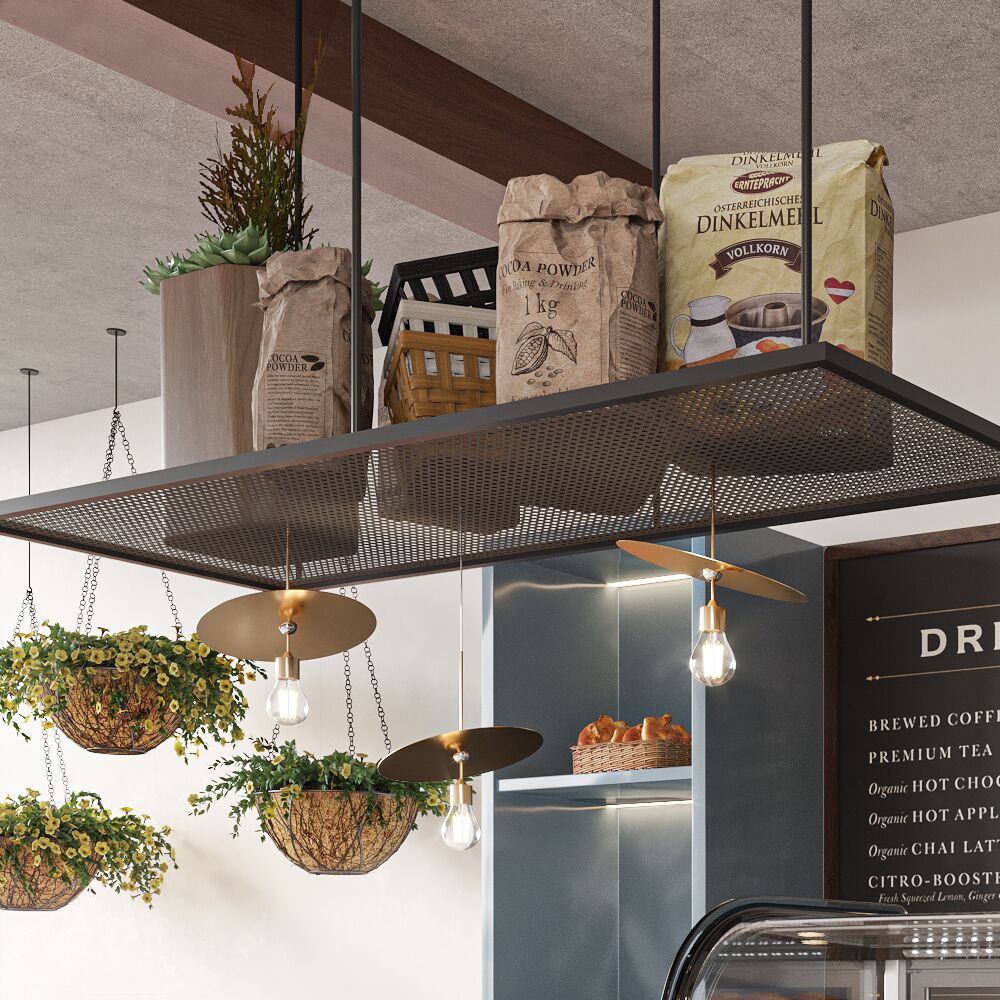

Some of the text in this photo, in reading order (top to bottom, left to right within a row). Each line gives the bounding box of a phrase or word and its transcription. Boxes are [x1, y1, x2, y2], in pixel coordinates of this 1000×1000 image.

[734, 175, 790, 190] ERNTEPRACHT
[726, 243, 789, 260] VOLLKORN
[536, 256, 596, 277] POWDER
[536, 293, 559, 319] kg
[267, 354, 298, 362] OCOA
[267, 363, 308, 371] POWDER
[868, 714, 941, 732] BREWED
[868, 747, 952, 765] PREMIUM
[958, 744, 993, 759] TEA
[868, 782, 908, 798] Organic
[912, 779, 949, 793] HOT
[868, 812, 908, 829] Organic
[912, 808, 949, 823] HOT
[868, 843, 908, 860] Organic
[912, 841, 955, 856] CHAI
[878, 893, 898, 903] Fresh
[968, 890, 996, 903] Ginger
